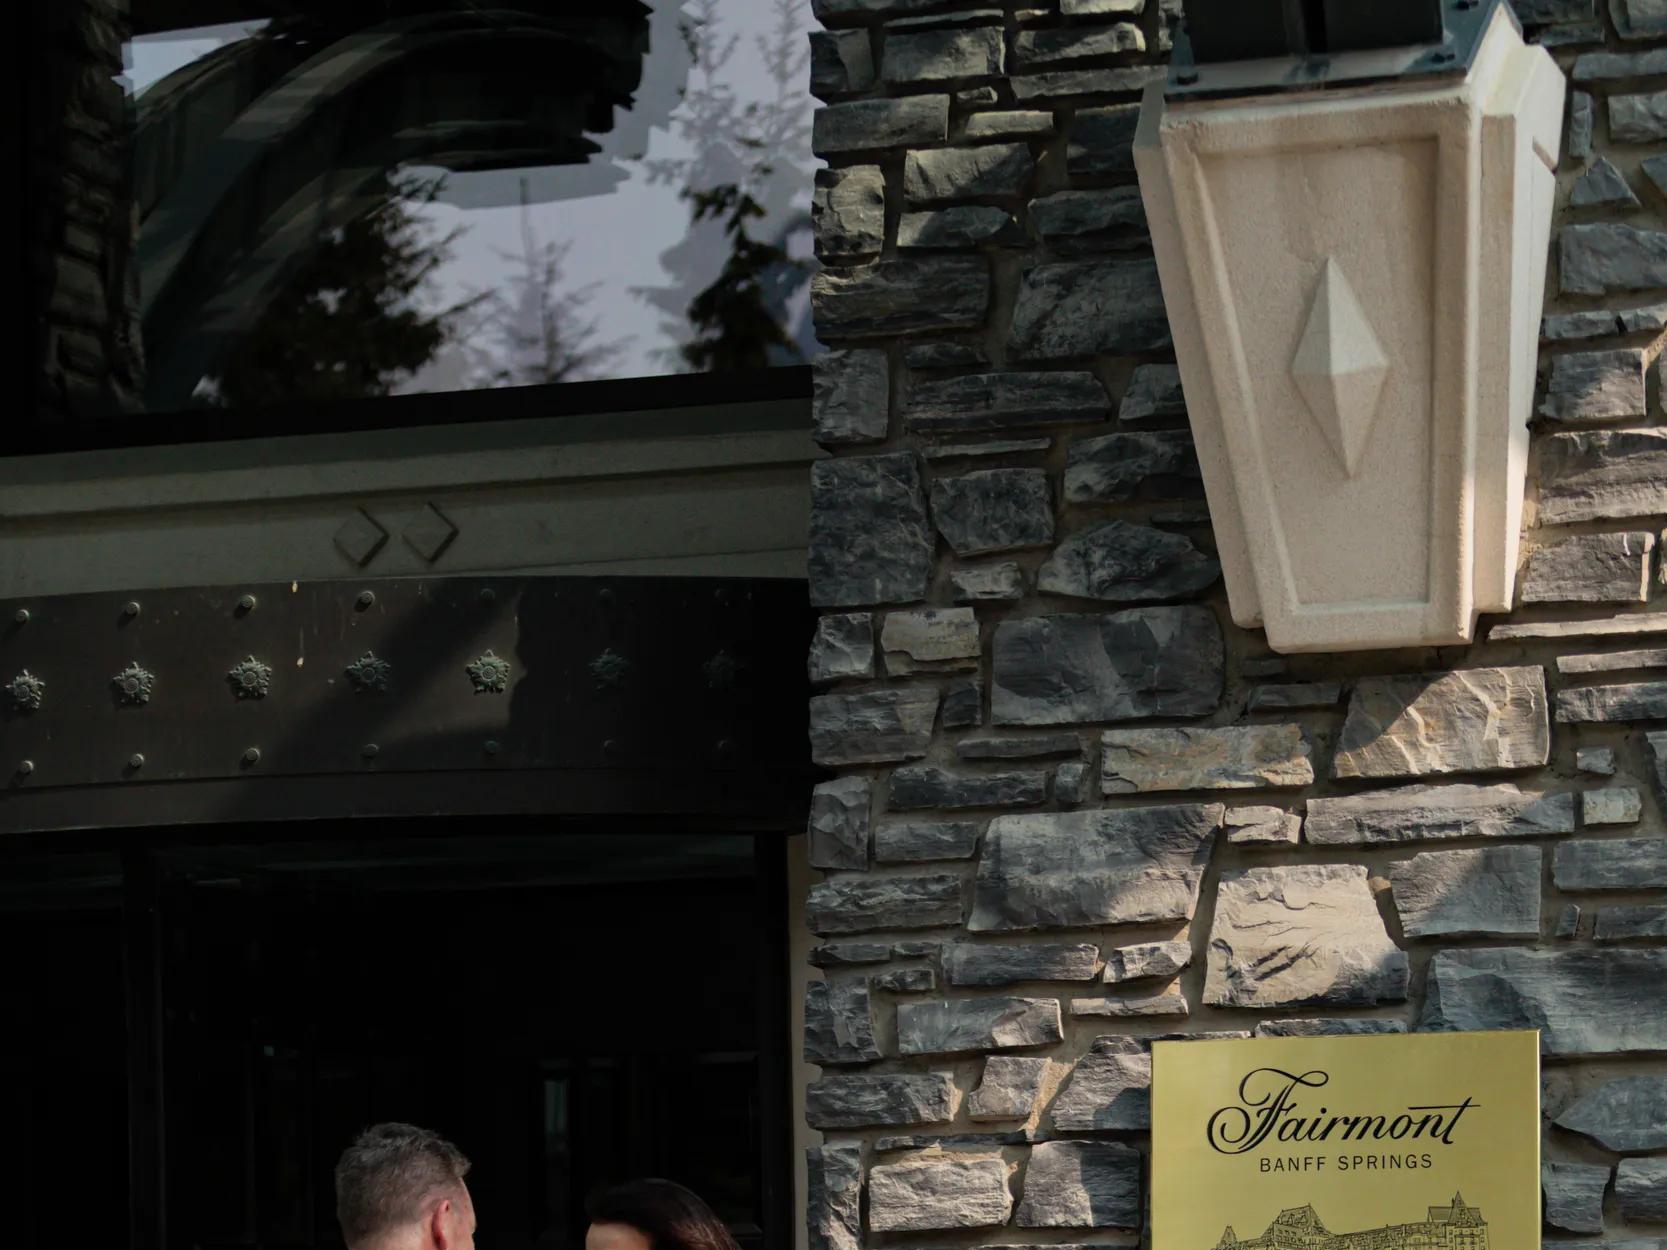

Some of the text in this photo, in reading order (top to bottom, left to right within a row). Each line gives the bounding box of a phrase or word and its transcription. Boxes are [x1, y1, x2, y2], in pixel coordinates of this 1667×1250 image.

[1207, 1067, 1481, 1155] Fairmont
[1260, 1153, 1432, 1173] BANFF SPRINGS
